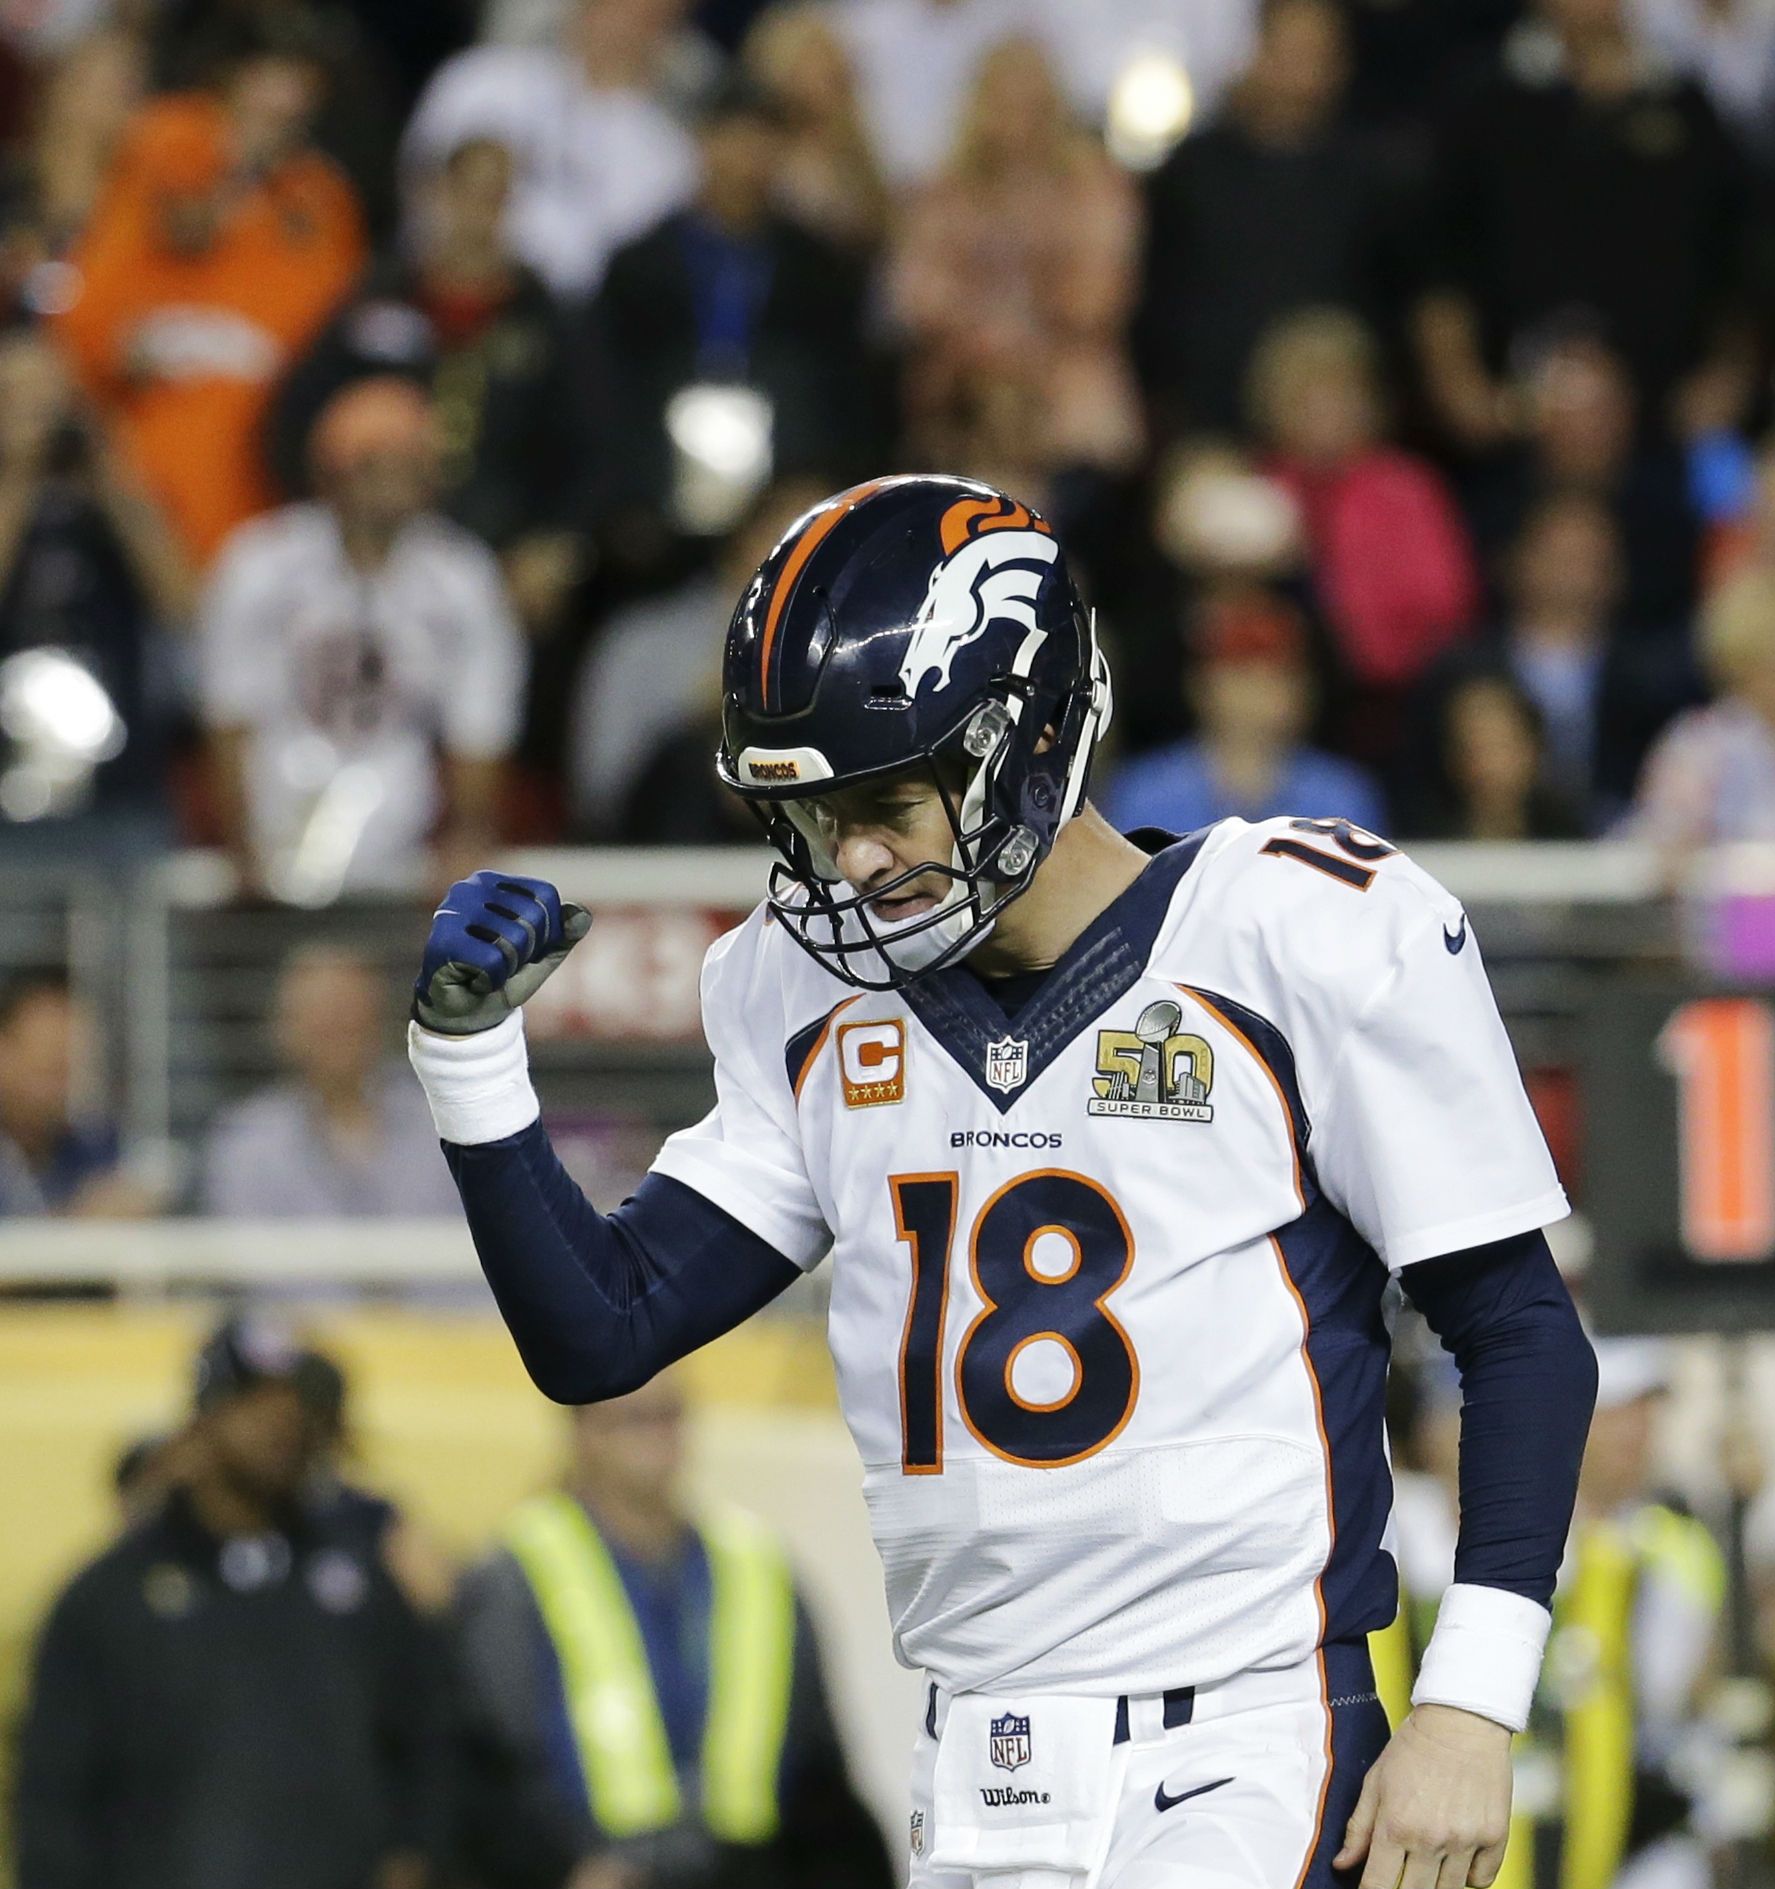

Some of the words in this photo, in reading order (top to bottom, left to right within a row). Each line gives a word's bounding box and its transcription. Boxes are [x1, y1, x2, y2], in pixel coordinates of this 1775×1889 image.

[842, 1025, 900, 1085] C
[1092, 1029, 1214, 1101] 50
[992, 1061, 1020, 1083] NFL
[1097, 1102, 1152, 1115] SUPER
[1159, 1106, 1205, 1119] BOWL
[950, 1131, 1062, 1149] BRONCOS
[888, 1167, 1141, 1475] 18
[992, 1737, 1028, 1766] NFL
